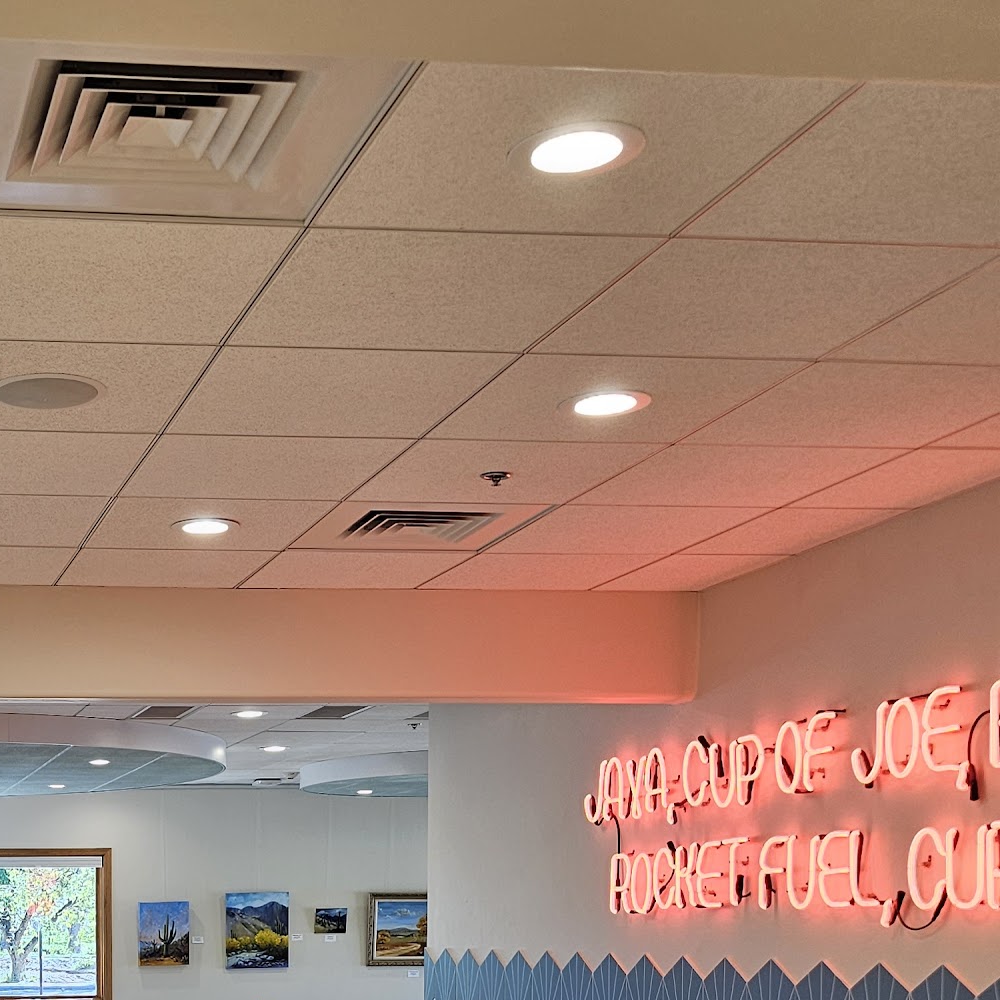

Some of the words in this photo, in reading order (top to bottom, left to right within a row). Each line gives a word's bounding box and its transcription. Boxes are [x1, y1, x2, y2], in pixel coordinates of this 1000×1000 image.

[682, 734, 764, 808] CUP
[775, 711, 839, 794] OF
[609, 837, 749, 914] ROCKET
